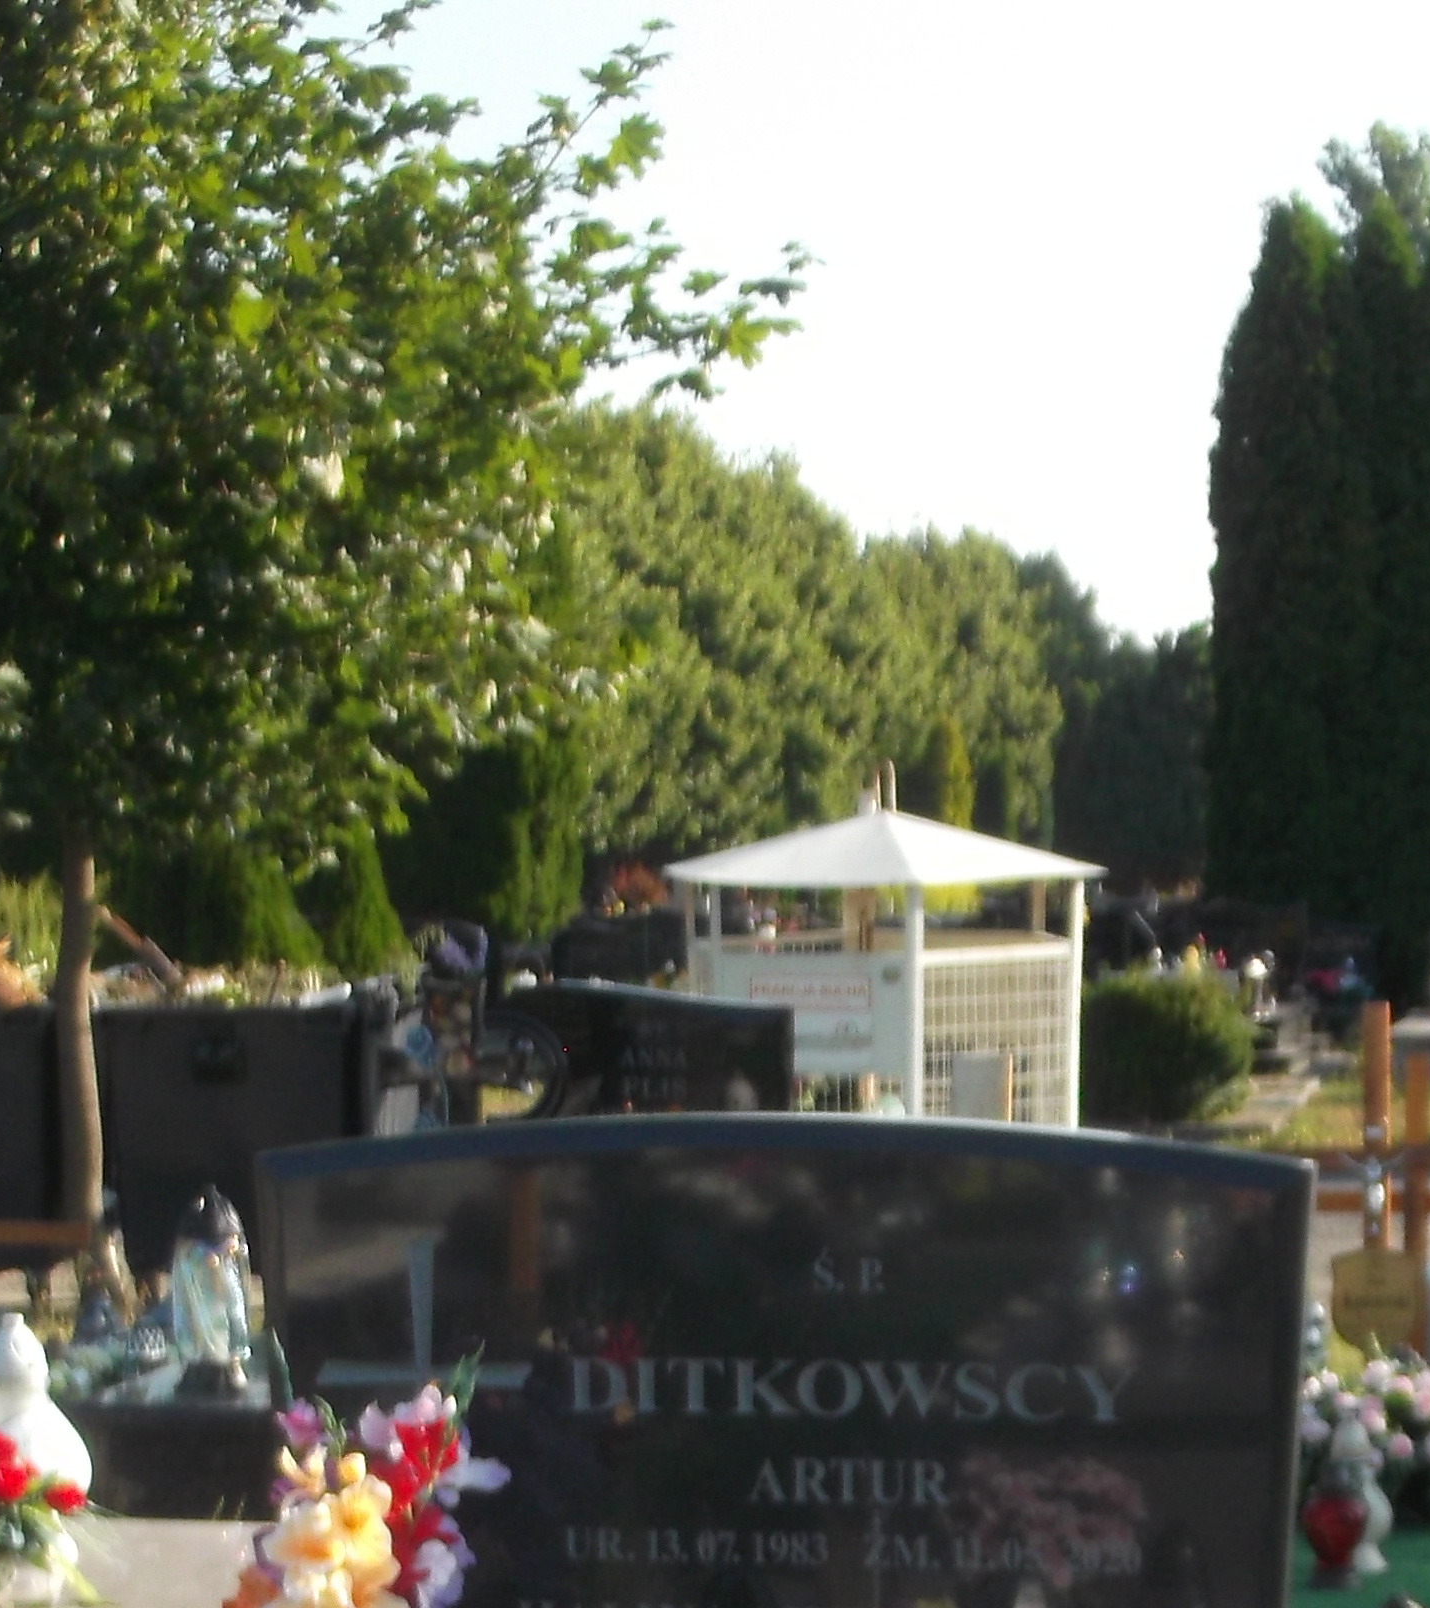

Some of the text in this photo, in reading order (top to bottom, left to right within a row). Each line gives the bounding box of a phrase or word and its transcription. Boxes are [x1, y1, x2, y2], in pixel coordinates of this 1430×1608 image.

[620, 1045, 688, 1070] ANNA
[569, 1356, 1136, 1423] DITKOWSCY
[746, 1456, 950, 1507] ARTUR
